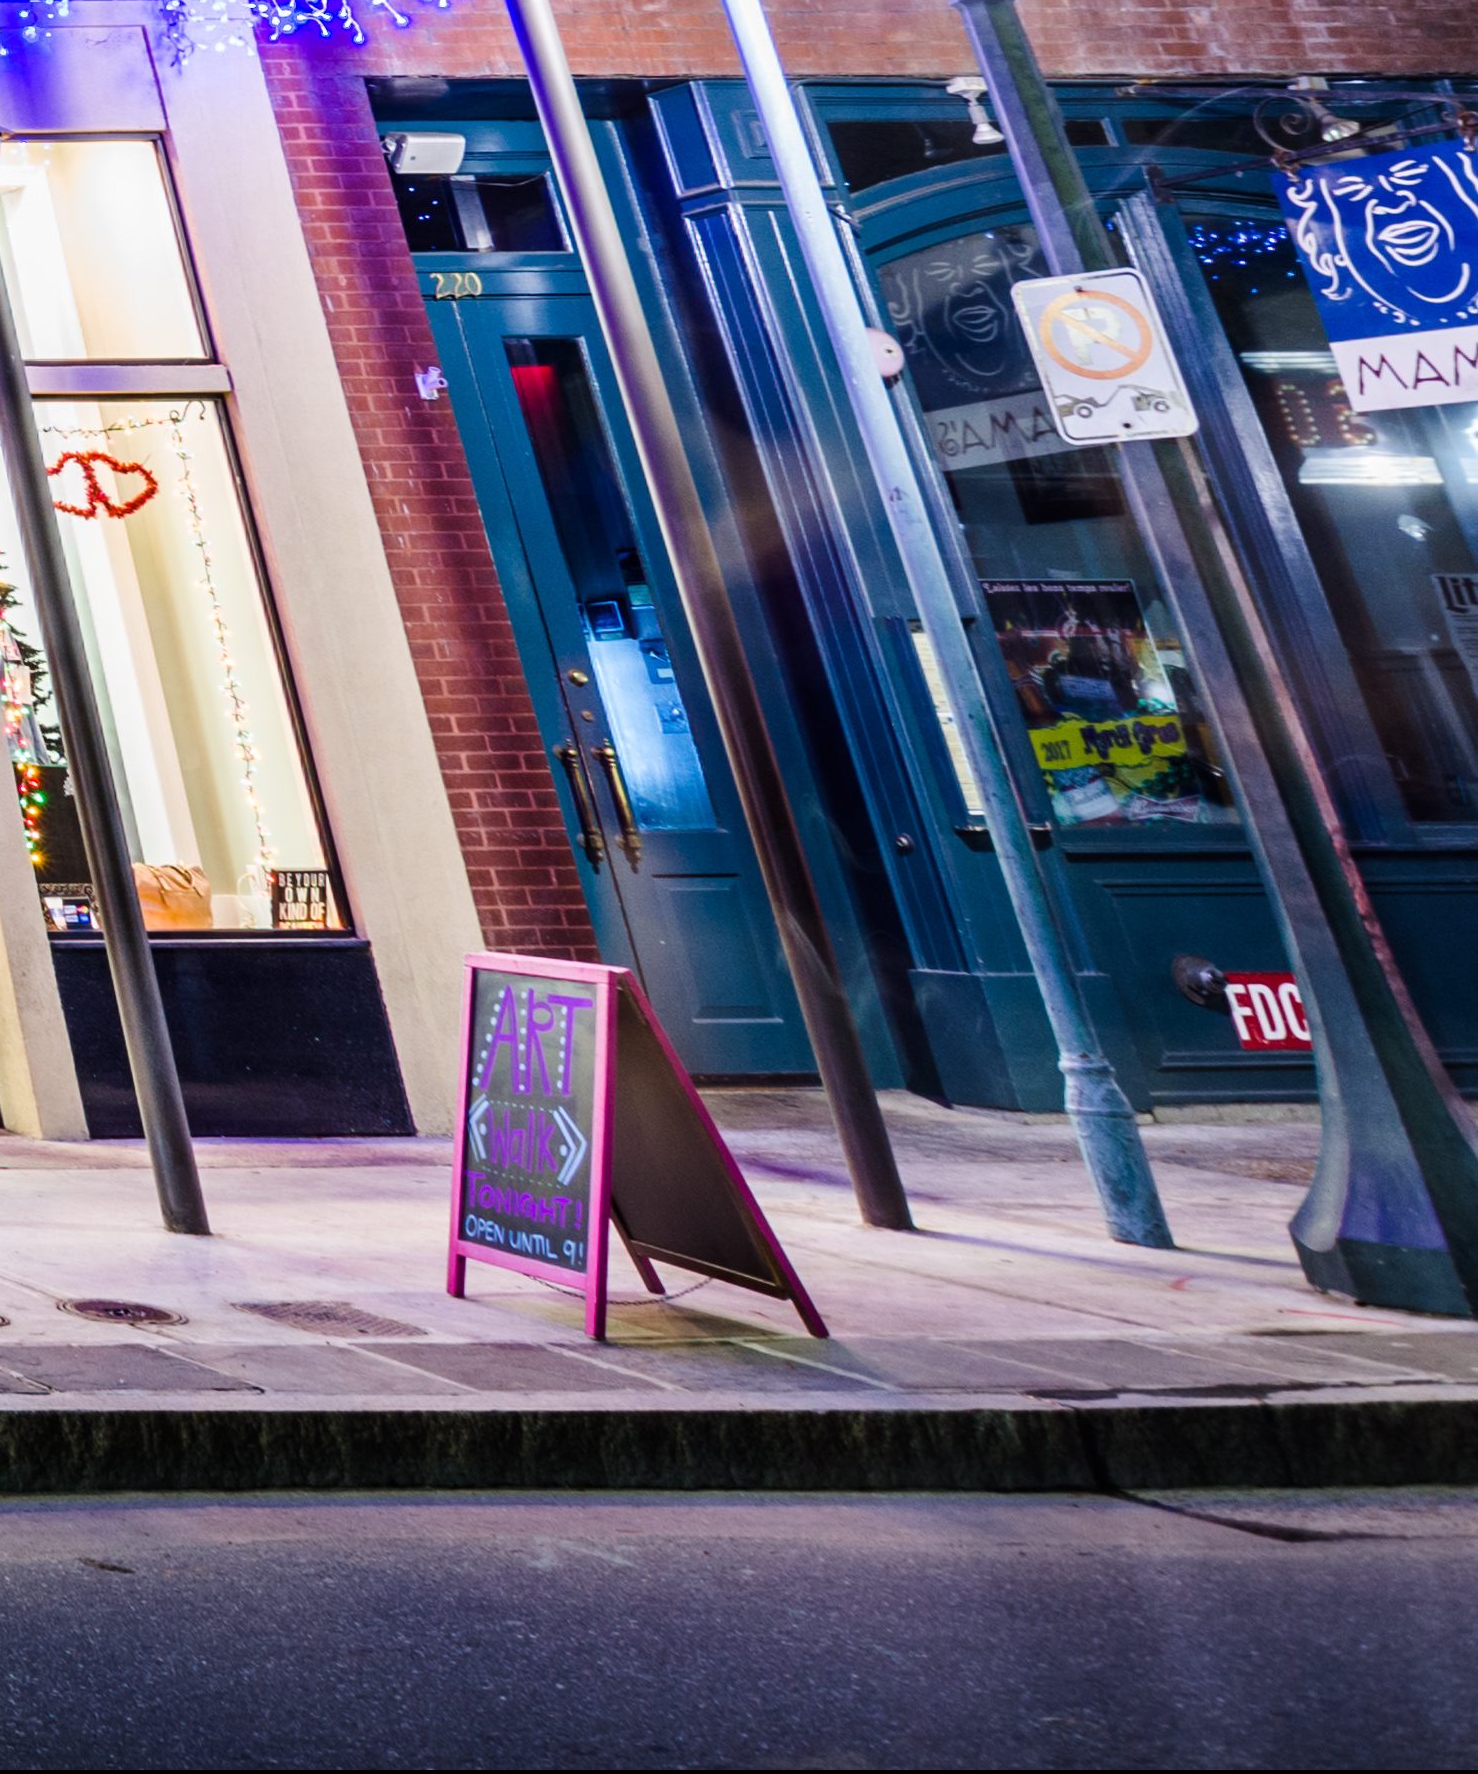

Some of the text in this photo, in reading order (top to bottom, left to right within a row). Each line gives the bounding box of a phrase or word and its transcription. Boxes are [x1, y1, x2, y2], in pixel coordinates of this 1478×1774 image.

[429, 272, 482, 299] 220
[1041, 740, 1072, 762] 2017
[278, 873, 325, 887] BE YOUR
[285, 887, 320, 903] OWN
[279, 903, 325, 920] KIND OF
[1223, 982, 1312, 1041] FDC
[479, 985, 593, 1096] ART
[486, 1106, 558, 1173] Walk
[465, 1214, 584, 1266] OPEN UNTIL 9!
